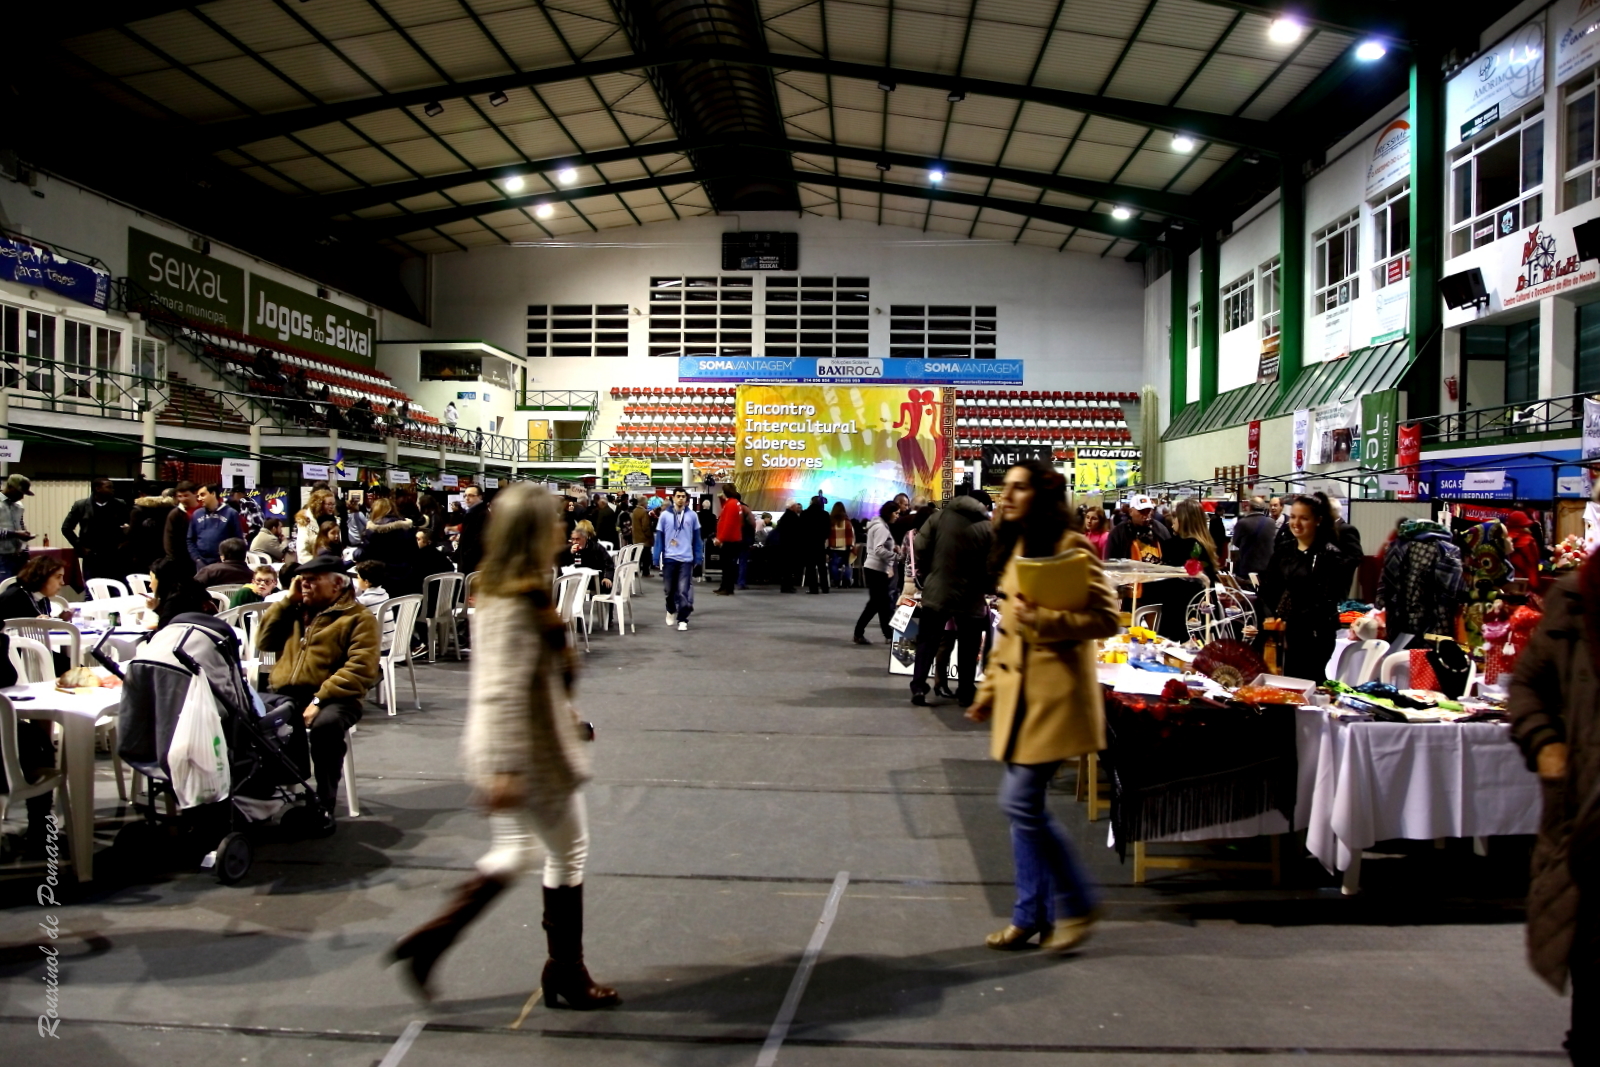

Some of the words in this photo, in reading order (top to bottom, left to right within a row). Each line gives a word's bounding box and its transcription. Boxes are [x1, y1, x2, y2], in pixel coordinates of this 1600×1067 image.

[1473, 73, 1508, 100] AMORIM
[0, 245, 50, 265] esporto
[14, 265, 42, 281] para
[1503, 297, 1515, 306] Centro
[1516, 290, 1530, 304] Cultural
[1562, 278, 1572, 289] Alto
[1578, 271, 1596, 283] Moinho
[185, 303, 229, 326] municipal
[256, 290, 314, 342] Jogos
[313, 325, 325, 344] do
[325, 314, 372, 358] Seixal
[698, 359, 793, 371] SOMAVANTAGEM
[818, 365, 882, 376] BAXIROCA
[924, 362, 1020, 373] SOMAVANTAGEM
[745, 401, 816, 416] Encontro
[745, 418, 858, 434] Intercultural
[744, 436, 806, 451] Saberes
[744, 457, 754, 467] e
[761, 453, 824, 468] Sabores
[1440, 480, 1457, 489] SAGA
